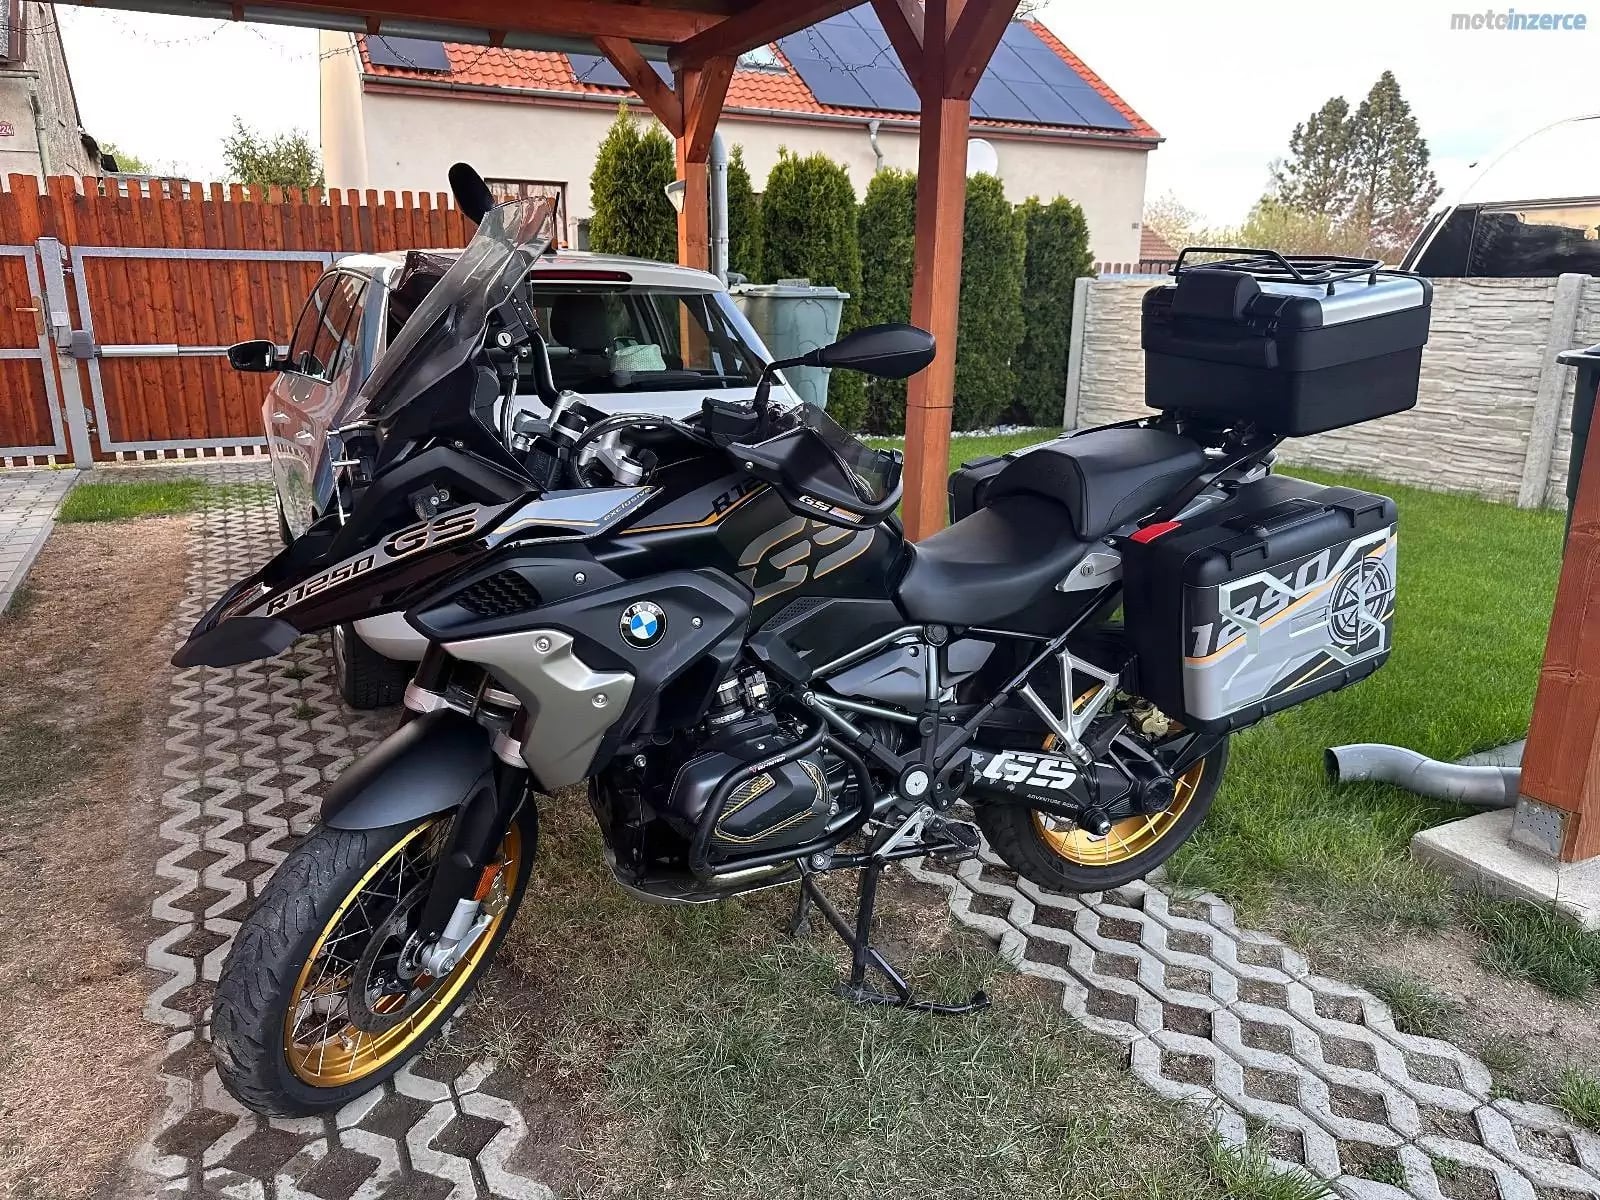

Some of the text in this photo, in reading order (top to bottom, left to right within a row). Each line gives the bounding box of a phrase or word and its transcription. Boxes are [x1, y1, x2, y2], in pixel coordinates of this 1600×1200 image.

[0, 125, 11, 134] 24
[604, 487, 652, 521] exclusive
[799, 495, 833, 511] GS
[266, 507, 479, 617] R1250 GS
[620, 603, 664, 625] BMW
[982, 750, 1078, 790] GS
[1026, 793, 1061, 805] ADVENTURE
